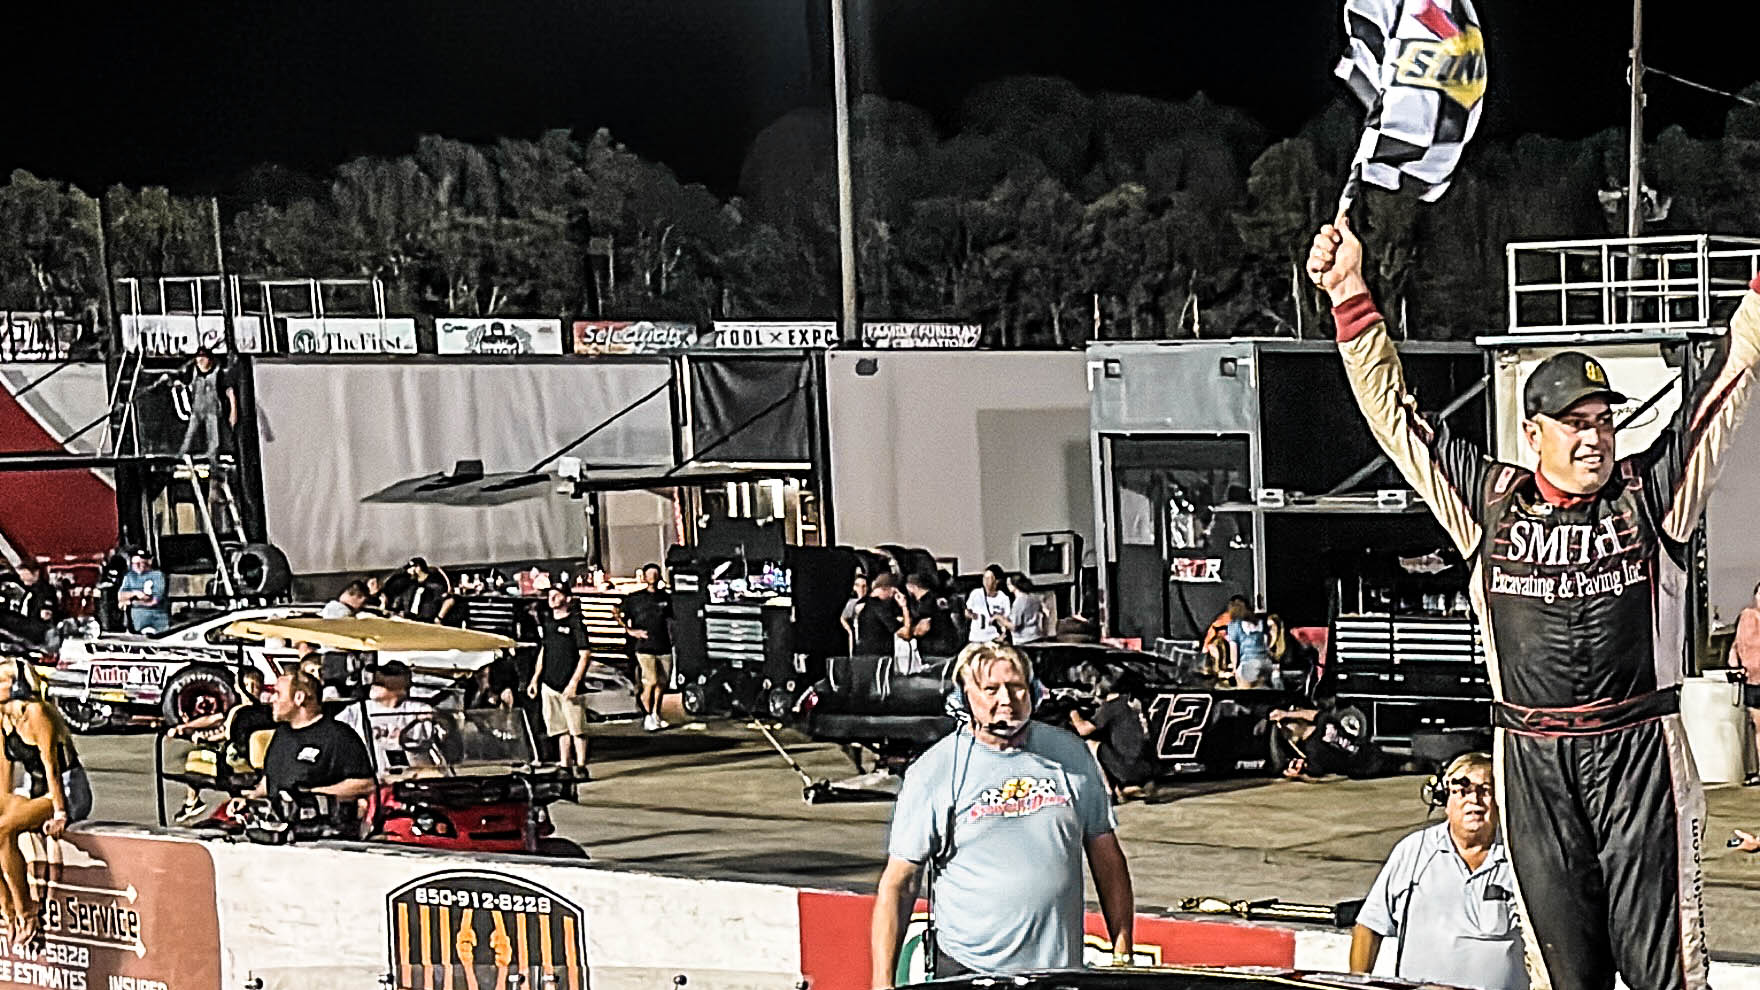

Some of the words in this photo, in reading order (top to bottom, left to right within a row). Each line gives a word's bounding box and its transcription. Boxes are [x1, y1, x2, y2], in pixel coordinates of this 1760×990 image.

[717, 329, 764, 347] TOOL
[1490, 567, 1555, 604] Excavating
[1557, 572, 1575, 599] &
[1575, 566, 1624, 597] Paving
[65, 896, 140, 943] Service
